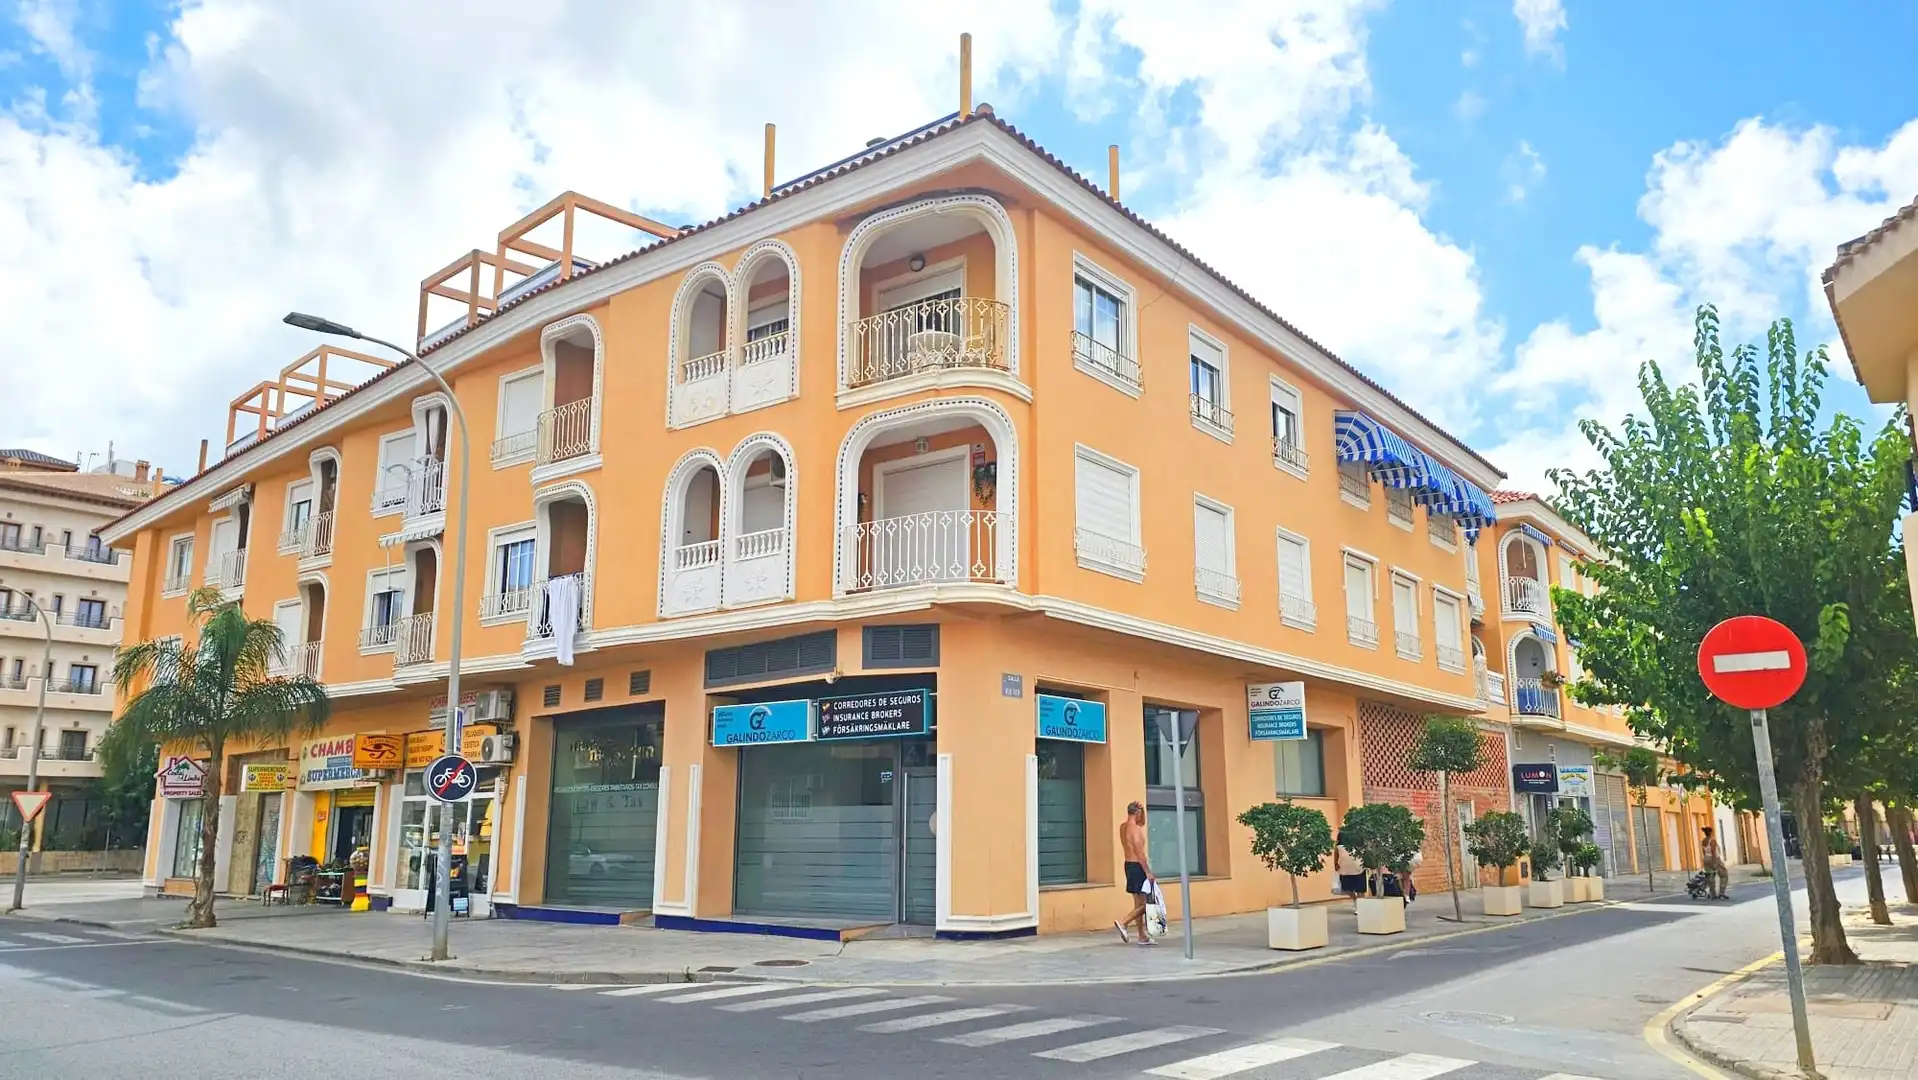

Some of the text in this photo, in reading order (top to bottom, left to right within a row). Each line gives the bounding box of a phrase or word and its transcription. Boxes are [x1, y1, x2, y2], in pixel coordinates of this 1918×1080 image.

[833, 695, 921, 710] CORREDORES DE SEGUROS
[1251, 699, 1300, 708] GALINDOZARCO
[833, 709, 902, 722] INSURANCE BROKERS
[833, 721, 910, 735] FÖRSÄKRINGSMÄKLARE
[1045, 725, 1100, 741] GALINDOZARCO
[727, 729, 796, 744] GALINDOZARCO
